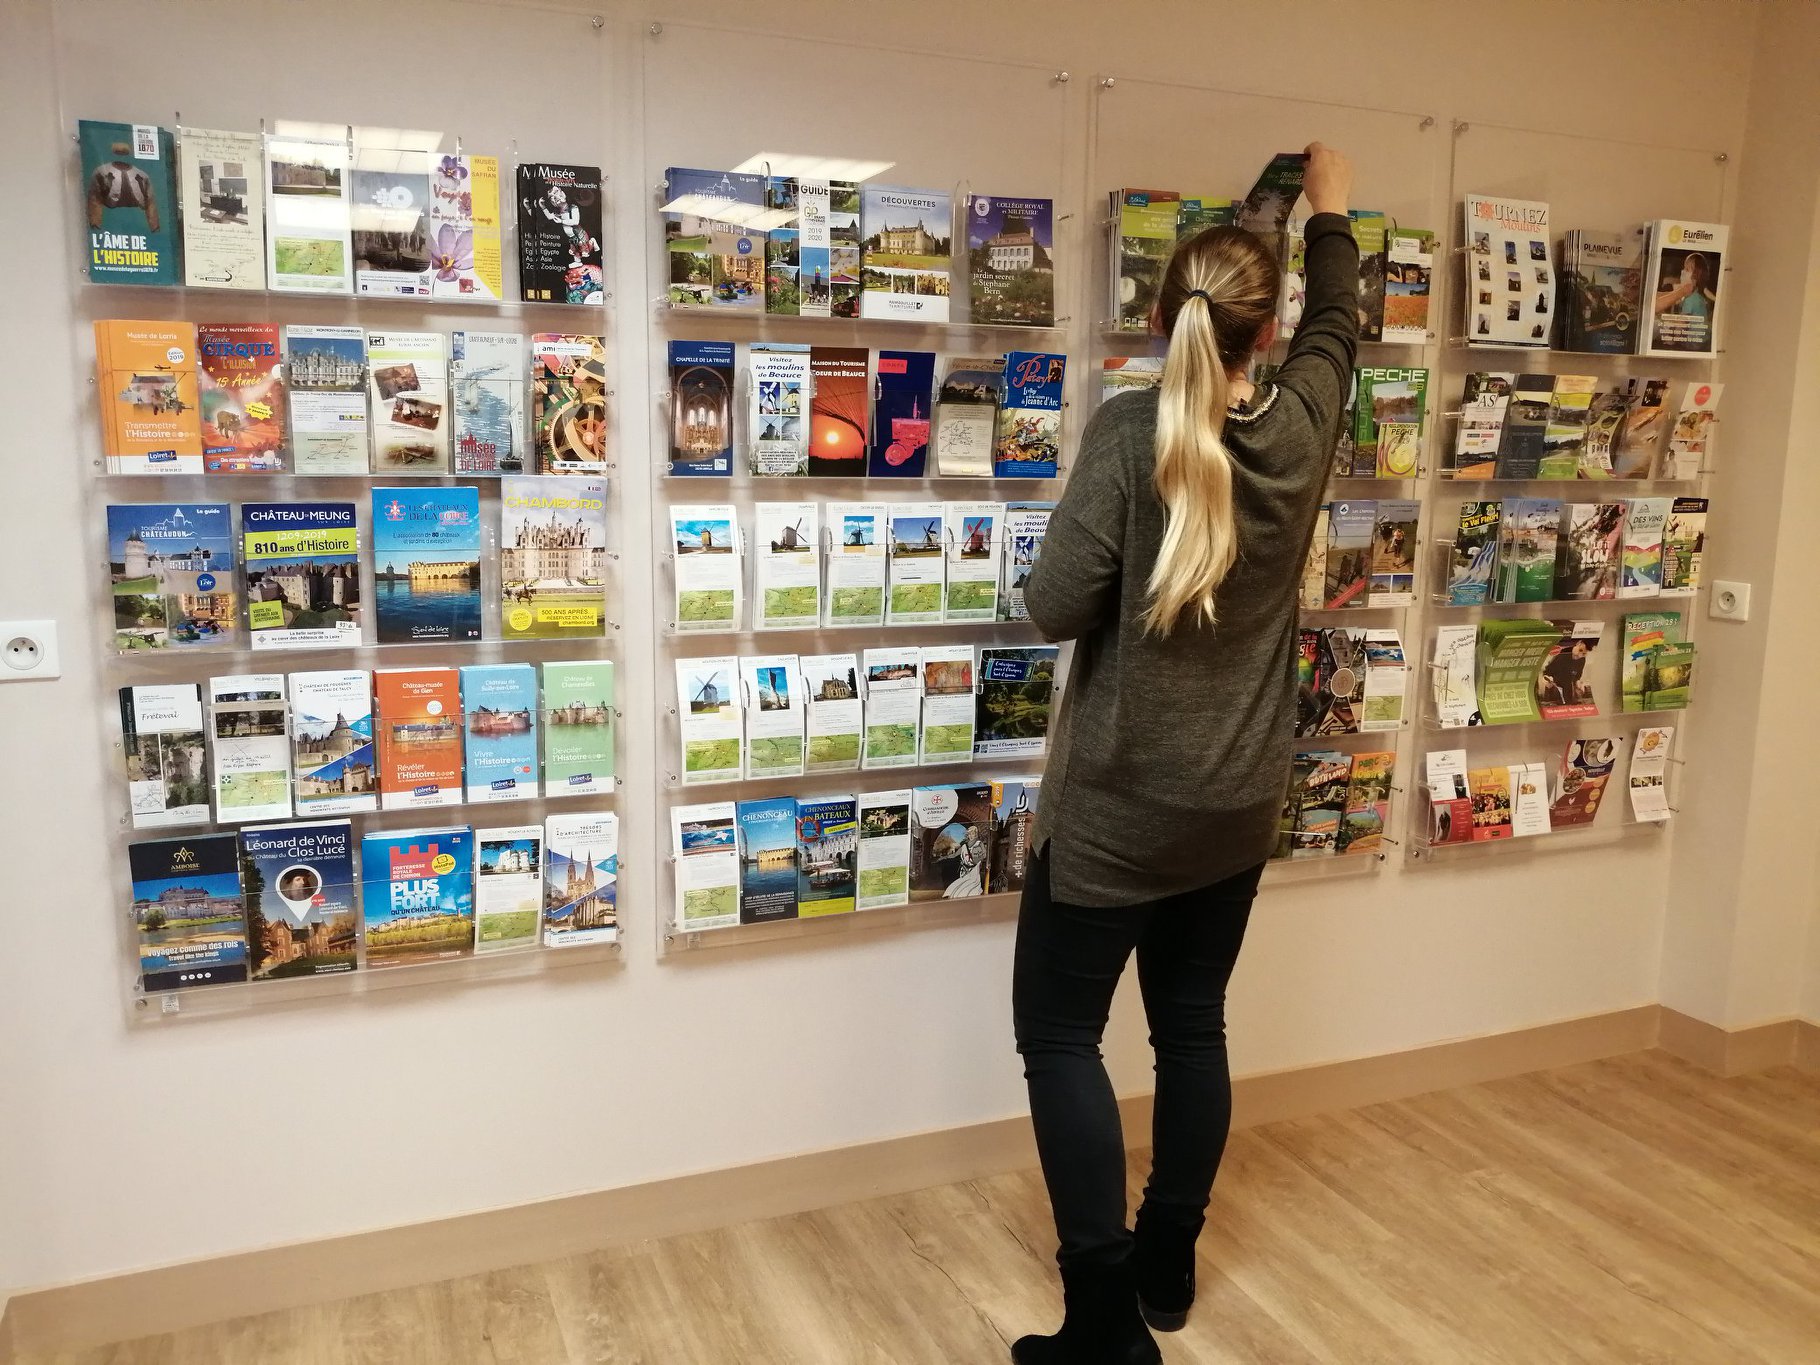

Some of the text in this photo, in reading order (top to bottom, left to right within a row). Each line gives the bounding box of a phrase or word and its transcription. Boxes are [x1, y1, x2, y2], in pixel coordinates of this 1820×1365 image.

[138, 144, 155, 152] 1870
[472, 172, 496, 180] SAFRAN
[538, 166, 575, 180] Musée
[574, 182, 598, 191] Naturelle
[800, 186, 829, 196] GUIDE
[881, 196, 936, 208] DÉCOUVERTES
[1359, 225, 1382, 233] Secrets
[540, 232, 561, 241] Histoire
[1683, 230, 1714, 241] Eurélien
[92, 231, 146, 251] L'ÂME DE
[540, 240, 562, 248] Peinture
[541, 248, 560, 257] Egypte
[1584, 243, 1623, 255] PLAINEVUE
[94, 250, 159, 266] L'HISTOIRE
[542, 264, 567, 272] Zoologie
[973, 272, 994, 280] jardin
[984, 286, 1001, 295] Bern
[202, 342, 275, 359] CIRQUE
[542, 345, 556, 353] ami
[768, 371, 802, 379] Beauce
[1012, 355, 1048, 389] Patay
[1361, 368, 1426, 382] PECHE
[232, 374, 261, 387] Année
[1025, 396, 1043, 407] Jeanne
[1044, 397, 1059, 406] d'Arc
[126, 430, 171, 438] l'Histoire
[460, 438, 496, 455] musée
[461, 461, 496, 471] DE LOIRE
[504, 496, 602, 511] CHAMBORD
[250, 510, 304, 521] CHÂTEAU
[310, 511, 350, 520] MEUNG
[410, 512, 468, 521] DE LA LOIRE
[141, 530, 186, 538] CHÂTEAUDUN
[254, 540, 349, 554] 810 ans d'Histoire
[474, 757, 511, 766] l'Histoire
[552, 753, 587, 761] l'Histoire
[397, 770, 435, 780] l'Histoire
[492, 781, 510, 789] Loiret
[805, 804, 851, 814] CHENONCEAUX
[742, 810, 793, 822] CHENONCEAU
[815, 810, 851, 820] BATEAUX
[559, 828, 602, 837] D'ARCHITECTURE
[1014, 817, 1026, 858] richesses
[246, 834, 345, 851] Léonard de Vinci
[288, 847, 314, 858] Clos
[317, 844, 345, 855] Lucé
[1013, 859, 1023, 870] de
[390, 879, 440, 897] PLUS
[391, 893, 440, 911] FORT
[148, 940, 239, 958] Voyagez comme des rois
